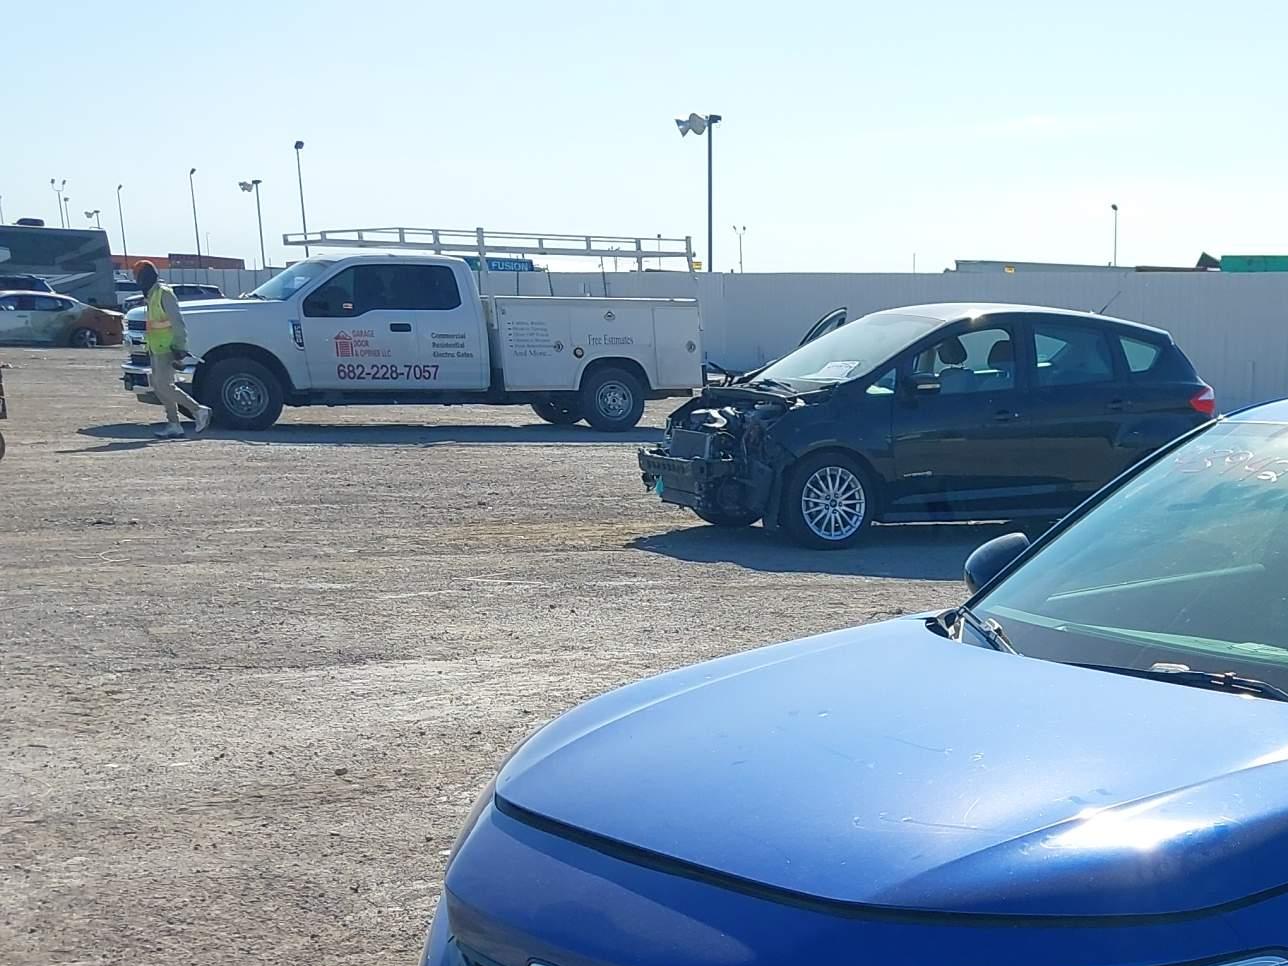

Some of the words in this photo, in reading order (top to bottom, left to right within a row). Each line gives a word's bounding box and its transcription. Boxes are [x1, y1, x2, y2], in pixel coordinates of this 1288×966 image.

[491, 261, 529, 271] FUSION
[431, 331, 466, 340] Commercial
[588, 334, 602, 346] Free
[603, 334, 634, 346] Estimates
[432, 341, 465, 349] Residential
[337, 363, 440, 381] 682-228-7057
